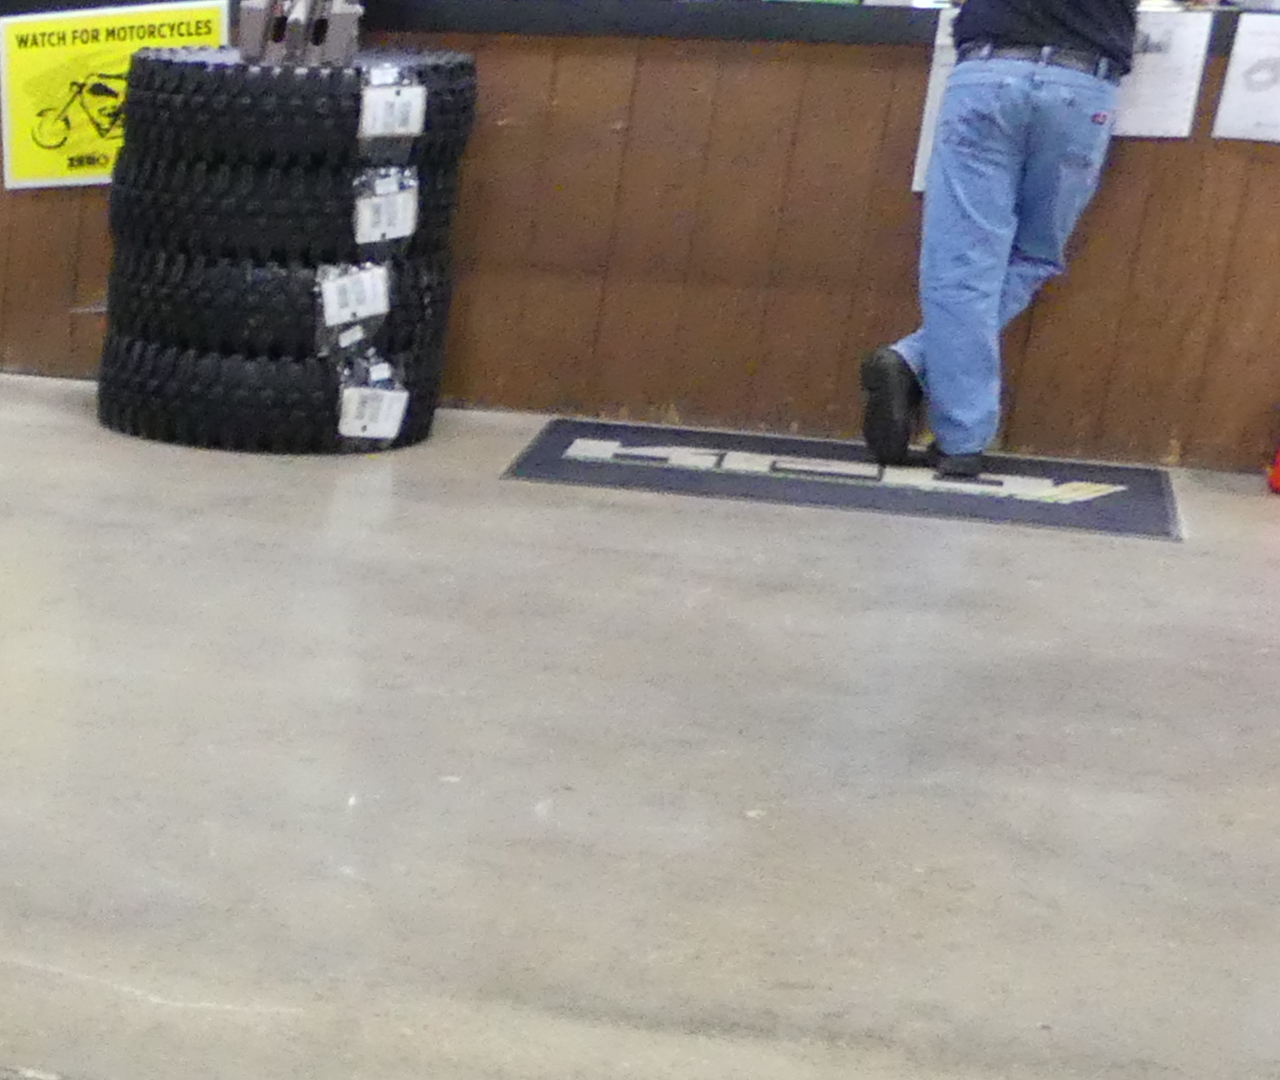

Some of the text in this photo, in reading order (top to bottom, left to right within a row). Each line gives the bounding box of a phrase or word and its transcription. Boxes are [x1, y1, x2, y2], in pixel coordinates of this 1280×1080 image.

[15, 20, 213, 49] WATCH FOR MOTORCYCLES
